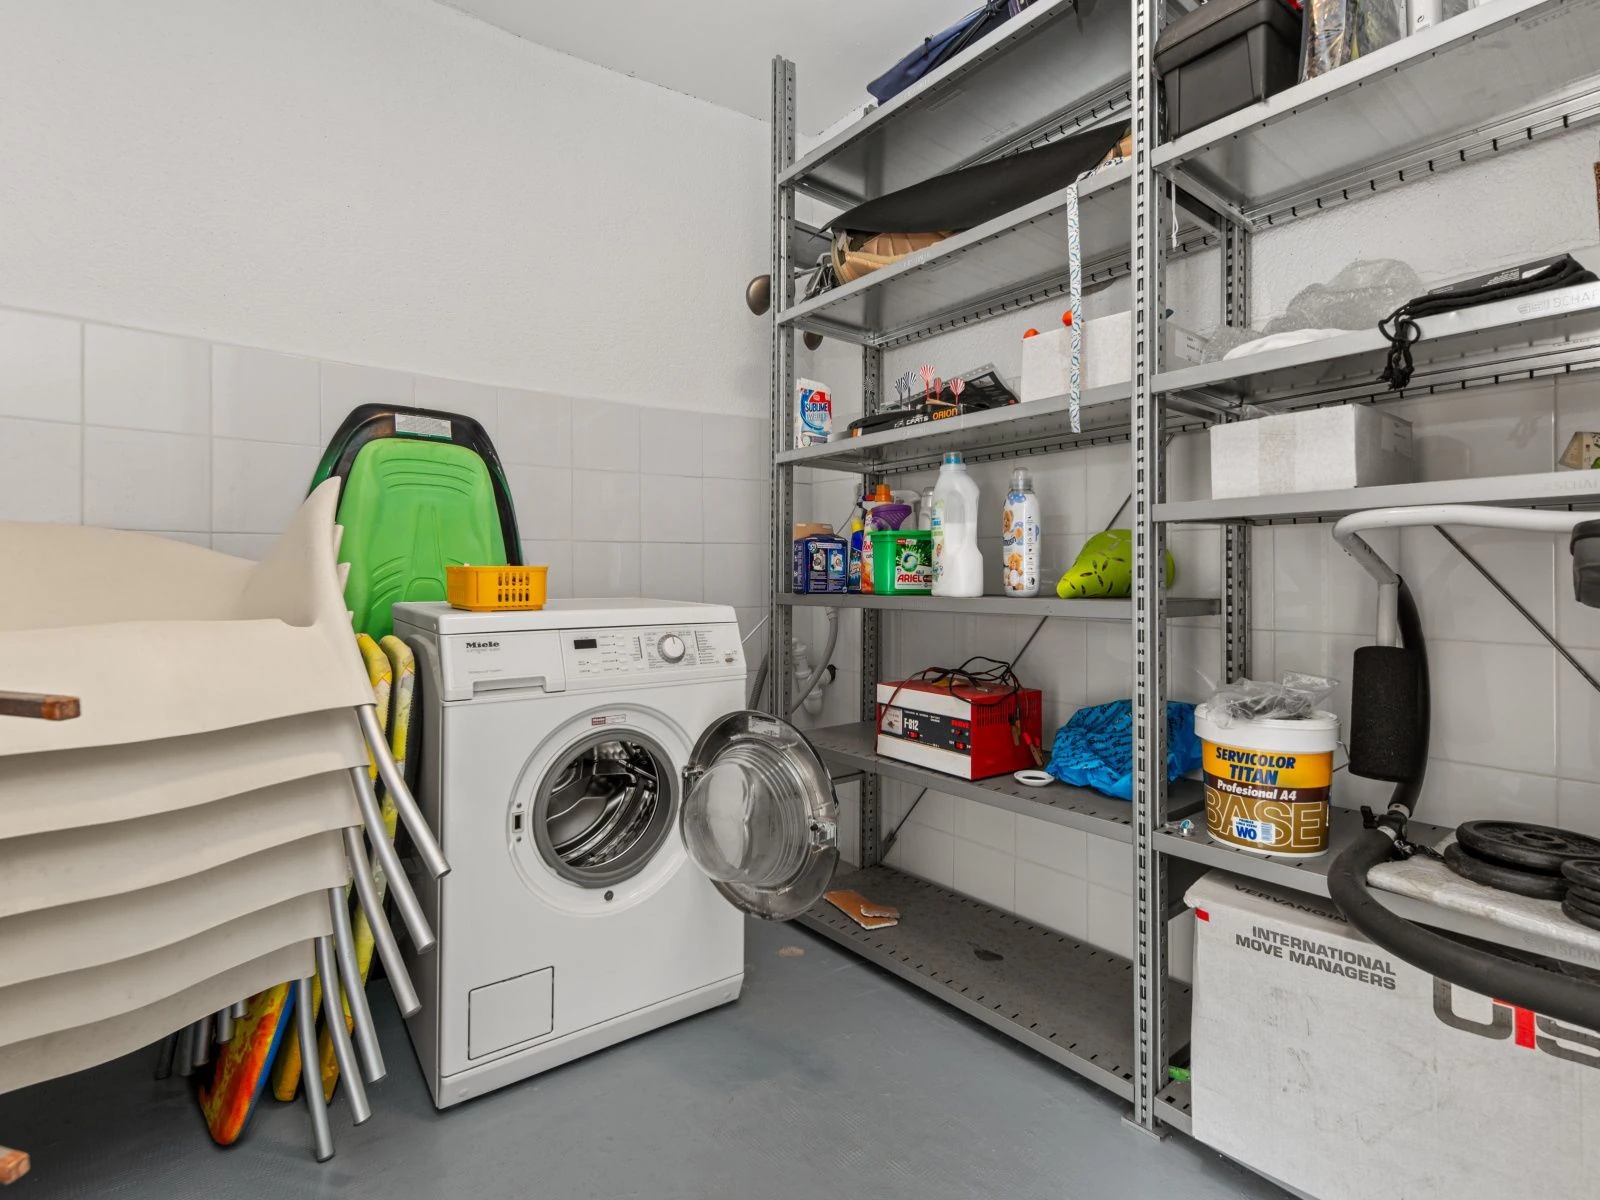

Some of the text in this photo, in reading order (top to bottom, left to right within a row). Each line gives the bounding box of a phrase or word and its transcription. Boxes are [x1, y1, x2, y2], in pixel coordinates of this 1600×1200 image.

[805, 402, 828, 412] SUBLIME
[932, 408, 958, 421] ORION
[897, 574, 922, 583] ARIEL
[466, 641, 500, 649] Miele
[1215, 747, 1296, 769] SERVICOLOR
[1229, 764, 1279, 785] TITAN
[1217, 779, 1297, 801] Profesional A4
[1206, 787, 1322, 848] BASE
[1235, 825, 1257, 840] WO
[1234, 884, 1348, 924] VERVANGIN
[1252, 926, 1396, 976] INTERNATIONAL
[1235, 934, 1397, 990] MOVE MANAGERS
